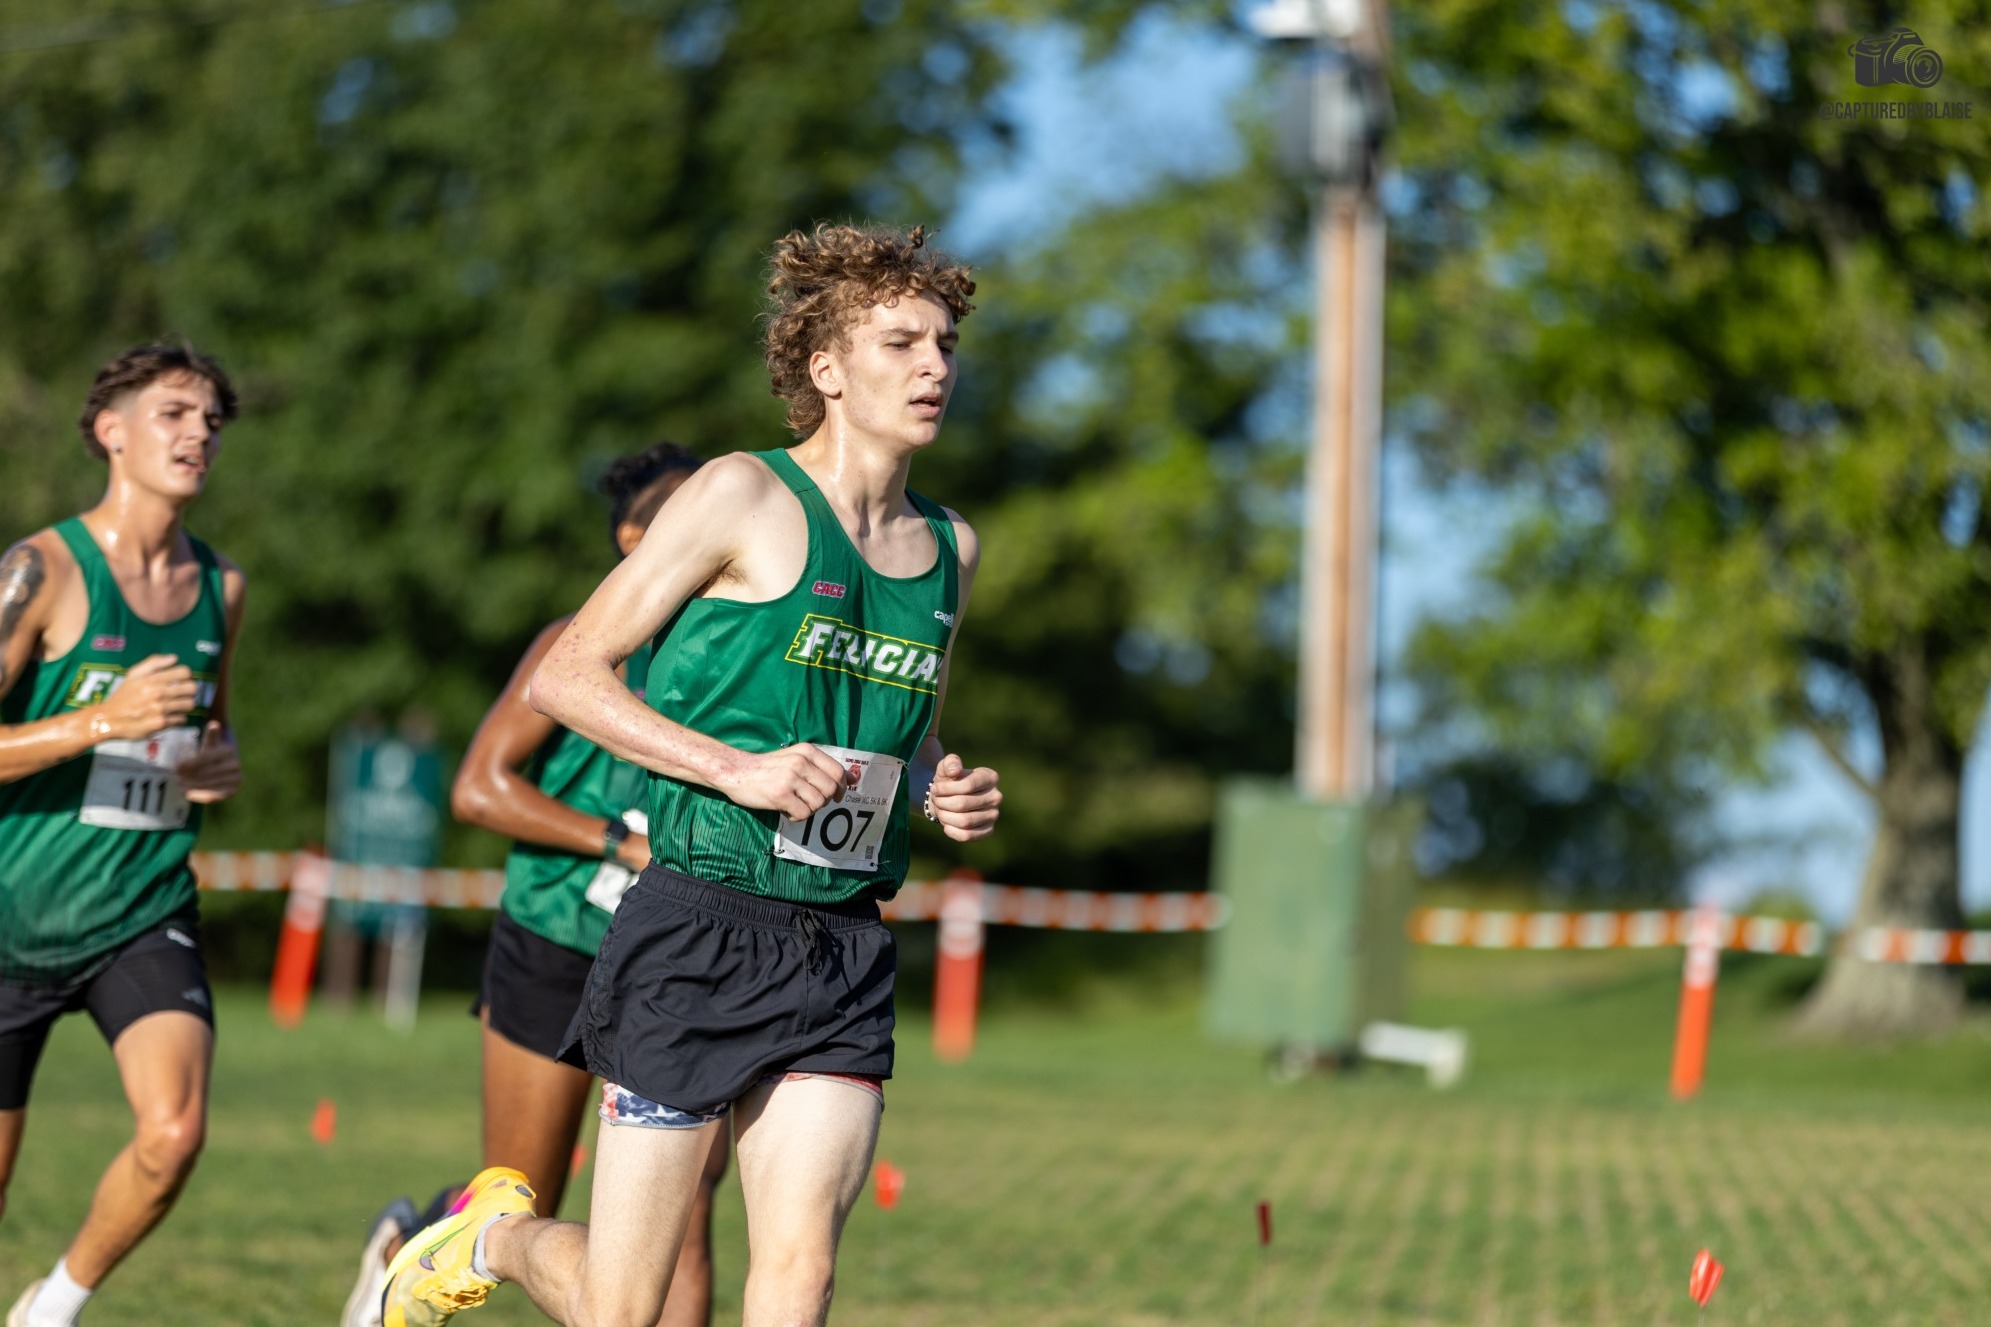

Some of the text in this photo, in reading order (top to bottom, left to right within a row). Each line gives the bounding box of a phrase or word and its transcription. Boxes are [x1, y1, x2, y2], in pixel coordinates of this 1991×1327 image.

[813, 581, 846, 598] CACC
[122, 778, 168, 814] 111
[801, 807, 876, 853] 107
